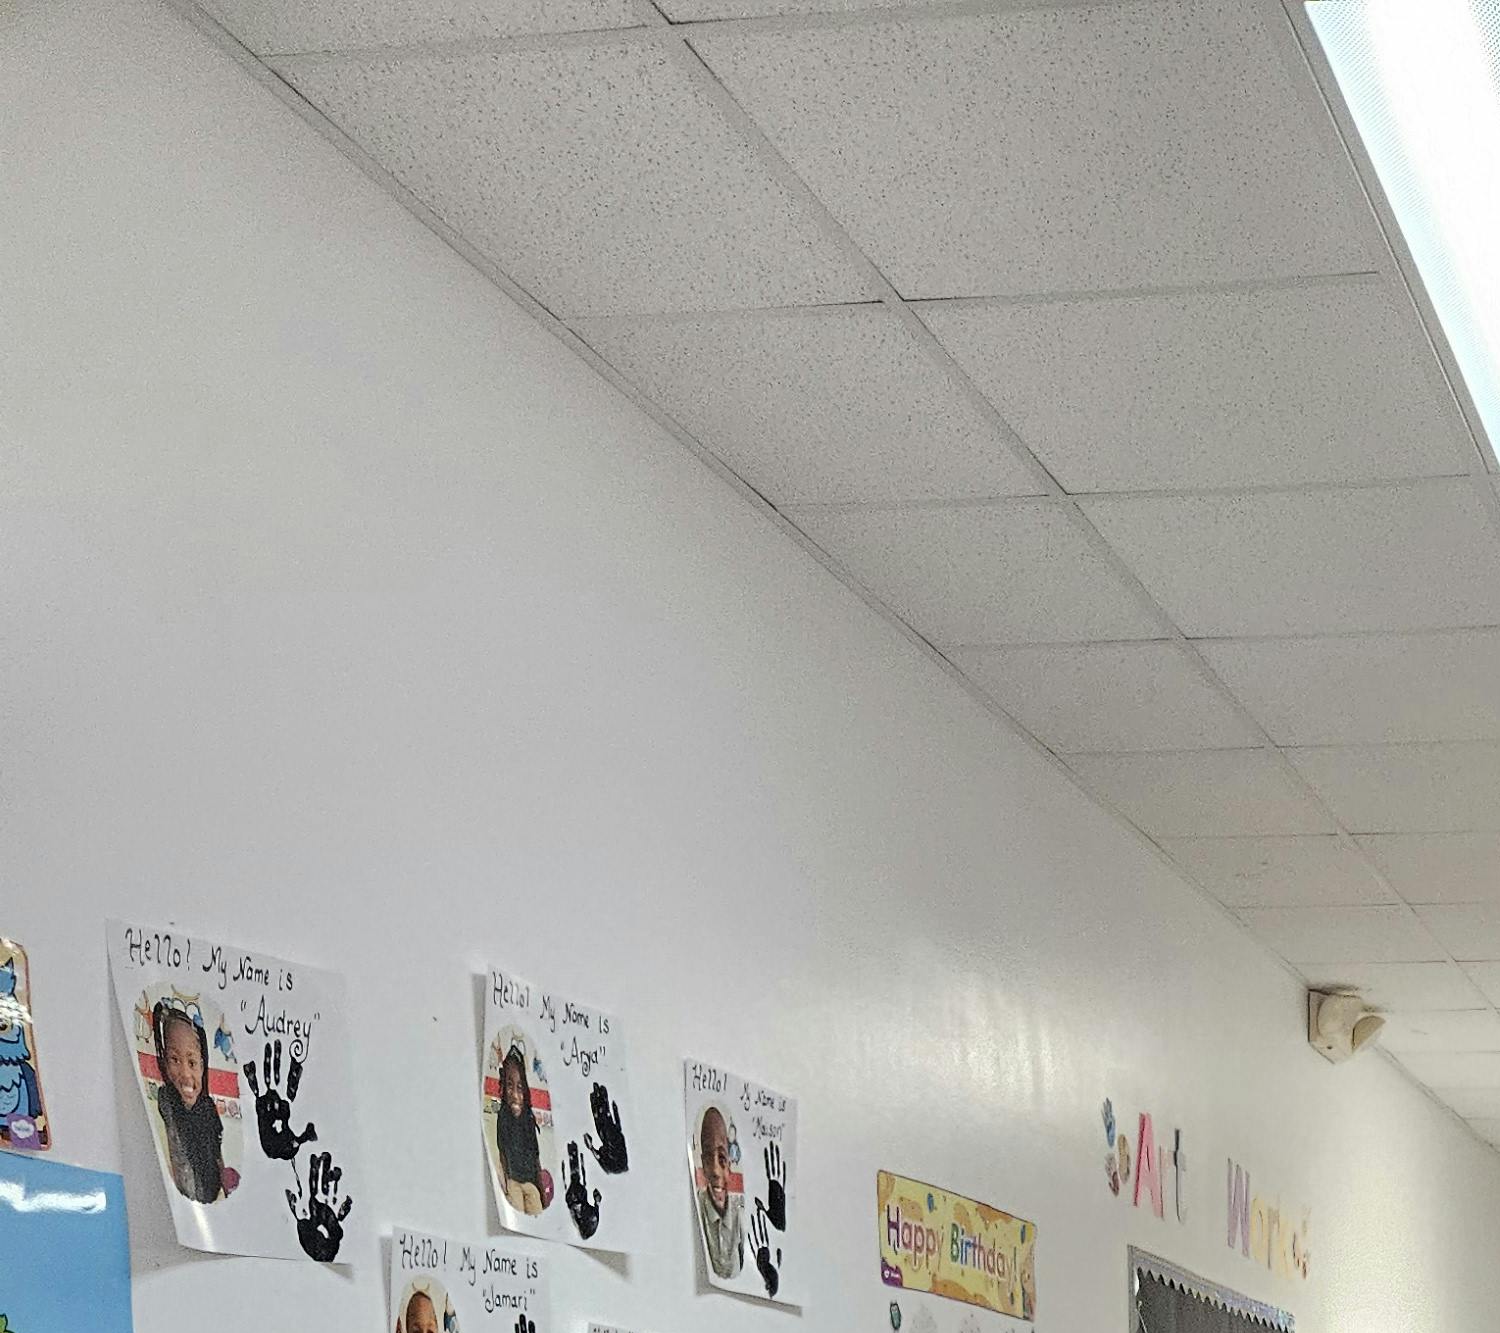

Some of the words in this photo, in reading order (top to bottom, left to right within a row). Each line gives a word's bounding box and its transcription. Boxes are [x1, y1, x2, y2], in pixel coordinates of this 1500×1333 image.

[125, 927, 191, 970] Hello!
[202, 946, 227, 990] My
[233, 956, 269, 986] Name
[279, 969, 293, 991] is
[400, 1233, 447, 1271] Hello!
[459, 1246, 477, 1287] My
[482, 1248, 518, 1276] Name
[526, 1257, 538, 1279] is
[887, 1204, 944, 1271] Happy
[950, 1223, 1017, 1296] Birthday!
